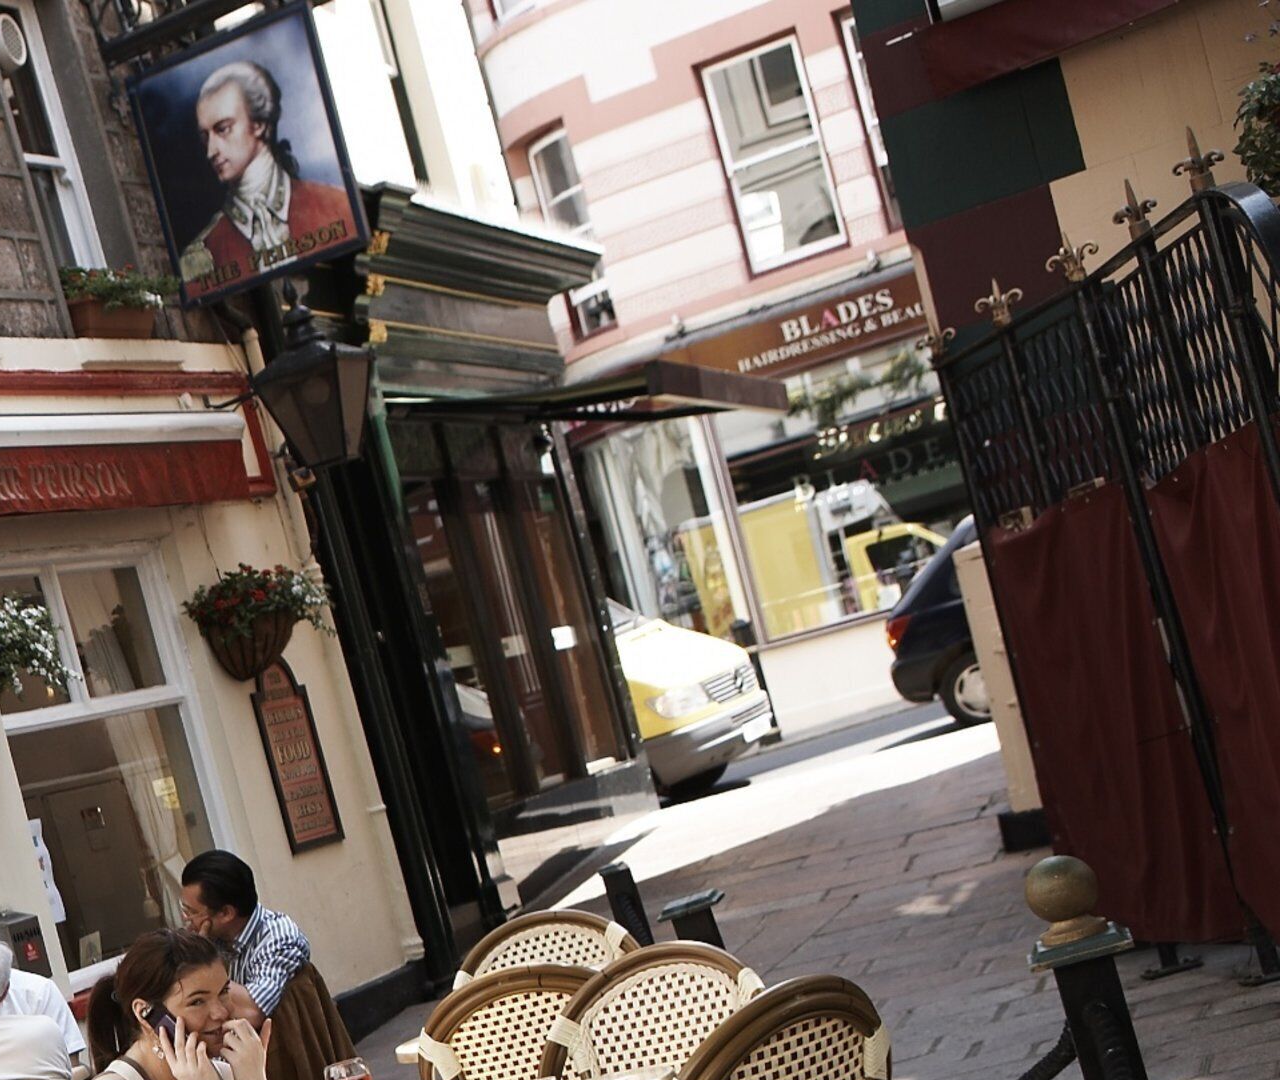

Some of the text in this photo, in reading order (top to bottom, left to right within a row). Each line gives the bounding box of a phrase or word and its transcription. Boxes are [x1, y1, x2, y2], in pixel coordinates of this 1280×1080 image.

[197, 220, 348, 291] THE PEIRSON
[780, 287, 894, 343] BLADES
[737, 321, 861, 374] HAIRDRESSING
[863, 316, 878, 333] &
[28, 461, 133, 500] PEIRSON
[276, 740, 312, 766] FOOD
